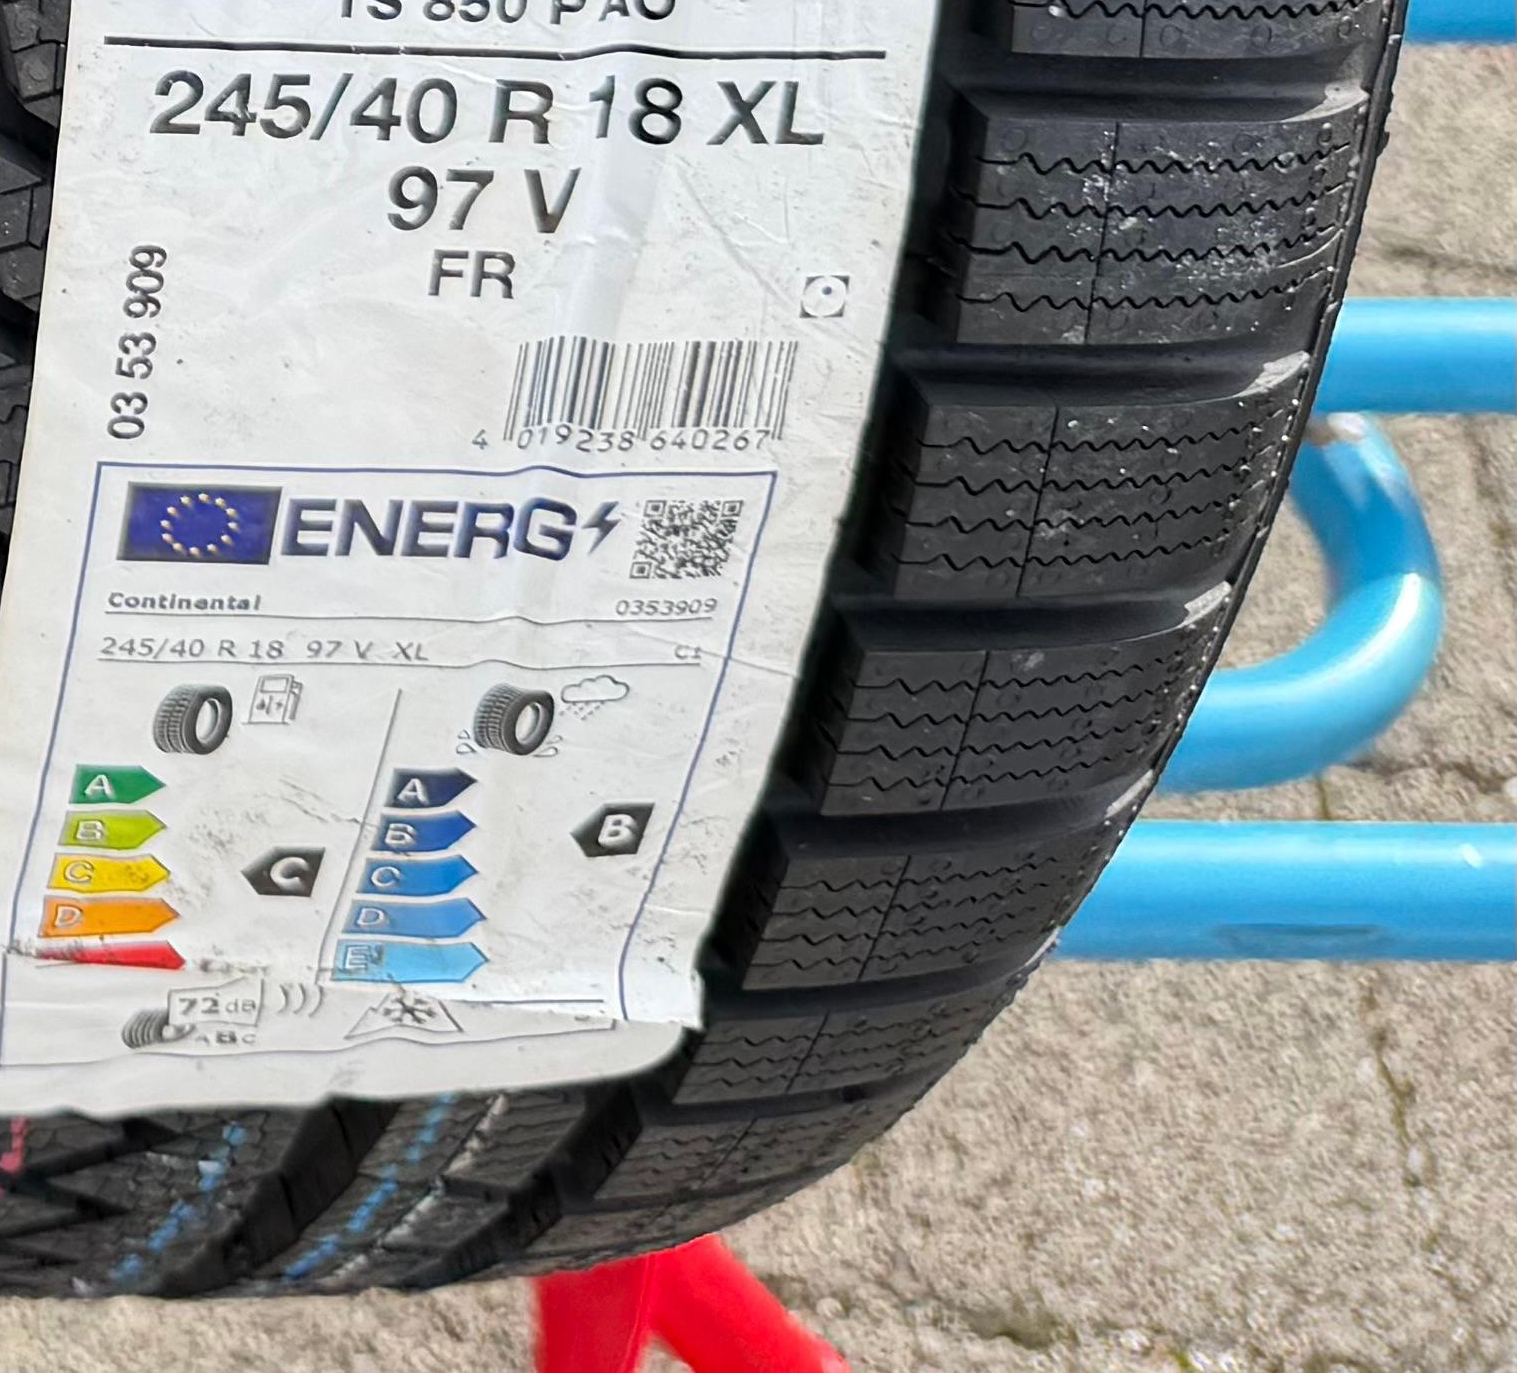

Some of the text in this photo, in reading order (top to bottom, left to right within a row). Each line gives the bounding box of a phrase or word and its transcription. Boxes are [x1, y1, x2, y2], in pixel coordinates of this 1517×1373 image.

[149, 71, 825, 146] 245/40 R 18 XL
[386, 165, 582, 236] 97 V
[428, 249, 517, 300] FR
[106, 244, 167, 440] 03 53 909
[471, 422, 771, 452] 4 019238 640267
[107, 592, 719, 616] Continental 0353909
[100, 636, 206, 660] 245/40
[217, 639, 236, 658] R
[251, 638, 285, 660] 18
[305, 639, 342, 659] 97
[353, 640, 374, 660] V
[392, 641, 430, 662] XL
[84, 774, 117, 800] A
[396, 777, 430, 805] A
[75, 819, 106, 843] B
[384, 823, 416, 847] B
[596, 813, 636, 847] B
[62, 860, 95, 885] C
[269, 856, 308, 889] C
[370, 865, 401, 889] C
[53, 905, 82, 929] D
[356, 906, 386, 928] D
[178, 996, 221, 1016] 72
